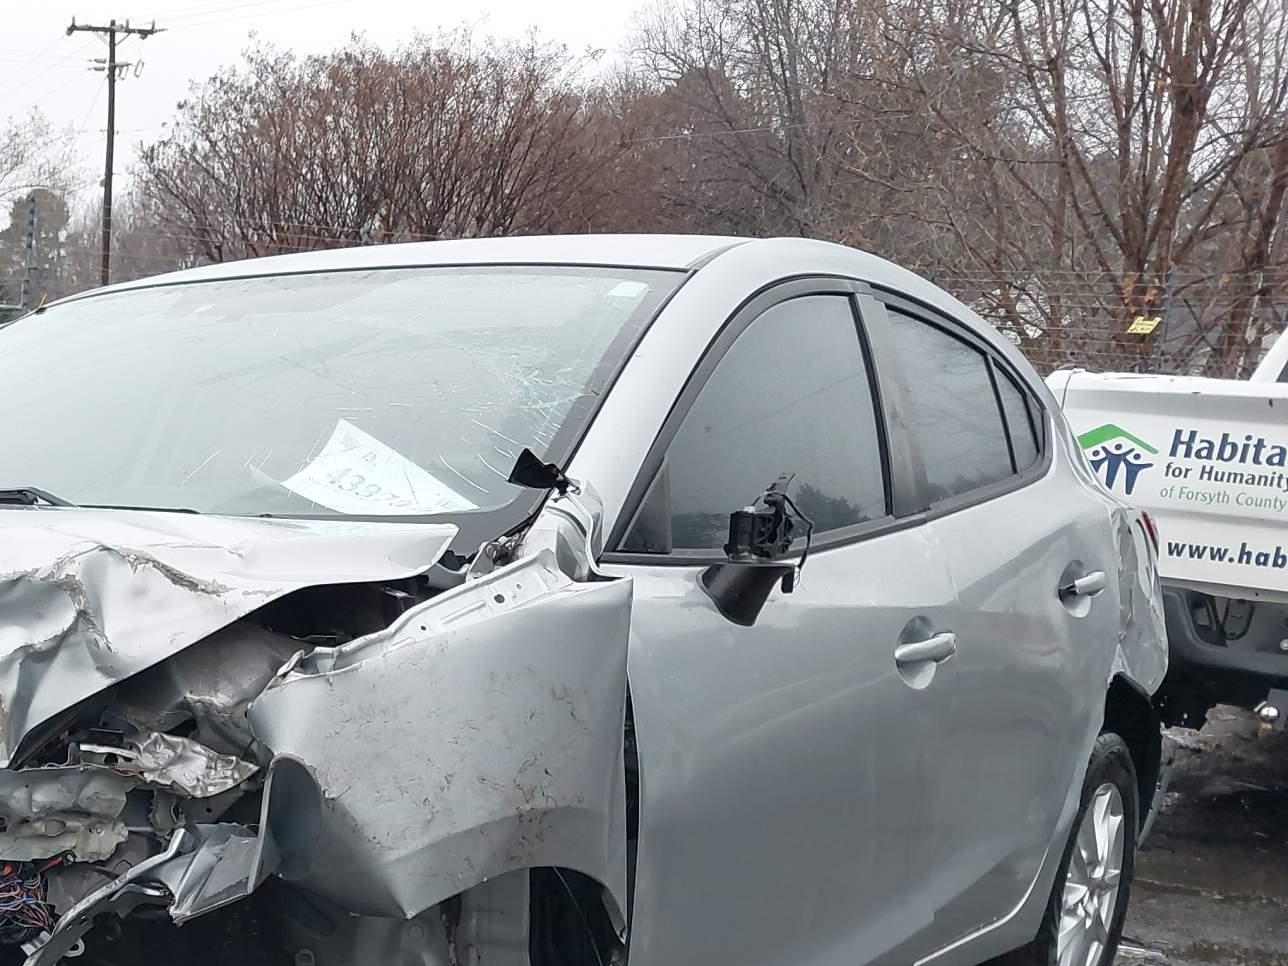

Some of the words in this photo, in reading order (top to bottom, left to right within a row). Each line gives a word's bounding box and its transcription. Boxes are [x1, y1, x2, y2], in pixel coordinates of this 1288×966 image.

[1169, 428, 1288, 467] Habita
[1164, 461, 1193, 479] for
[1160, 485, 1175, 499] of
[1178, 486, 1230, 505] Forsyth
[1236, 491, 1287, 512] County
[1167, 541, 1288, 569] www.hab
